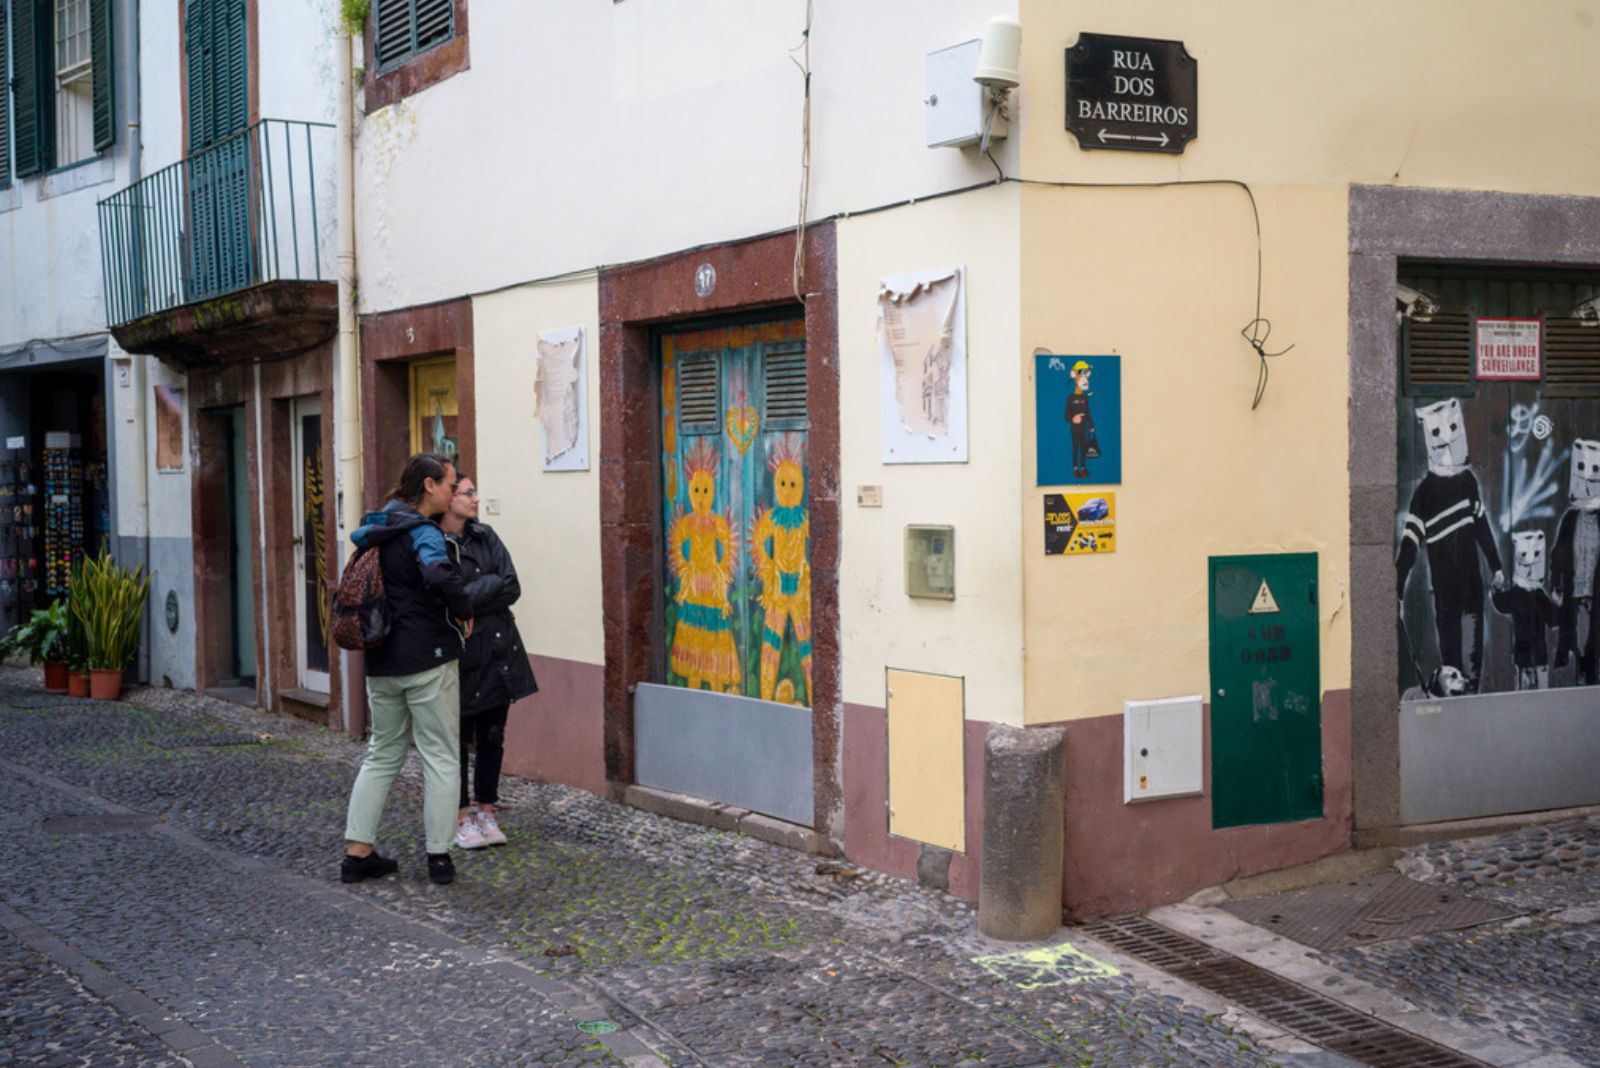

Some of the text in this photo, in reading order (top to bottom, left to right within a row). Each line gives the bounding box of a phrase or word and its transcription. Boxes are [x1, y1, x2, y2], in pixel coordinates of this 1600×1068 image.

[1113, 50, 1154, 71] RUA
[1114, 75, 1154, 97] DOS
[1078, 100, 1188, 126] BARREIROS
[1496, 344, 1510, 358] ARE
[1513, 345, 1537, 358] UNDER
[1481, 359, 1536, 373] SURVEILLANCE
